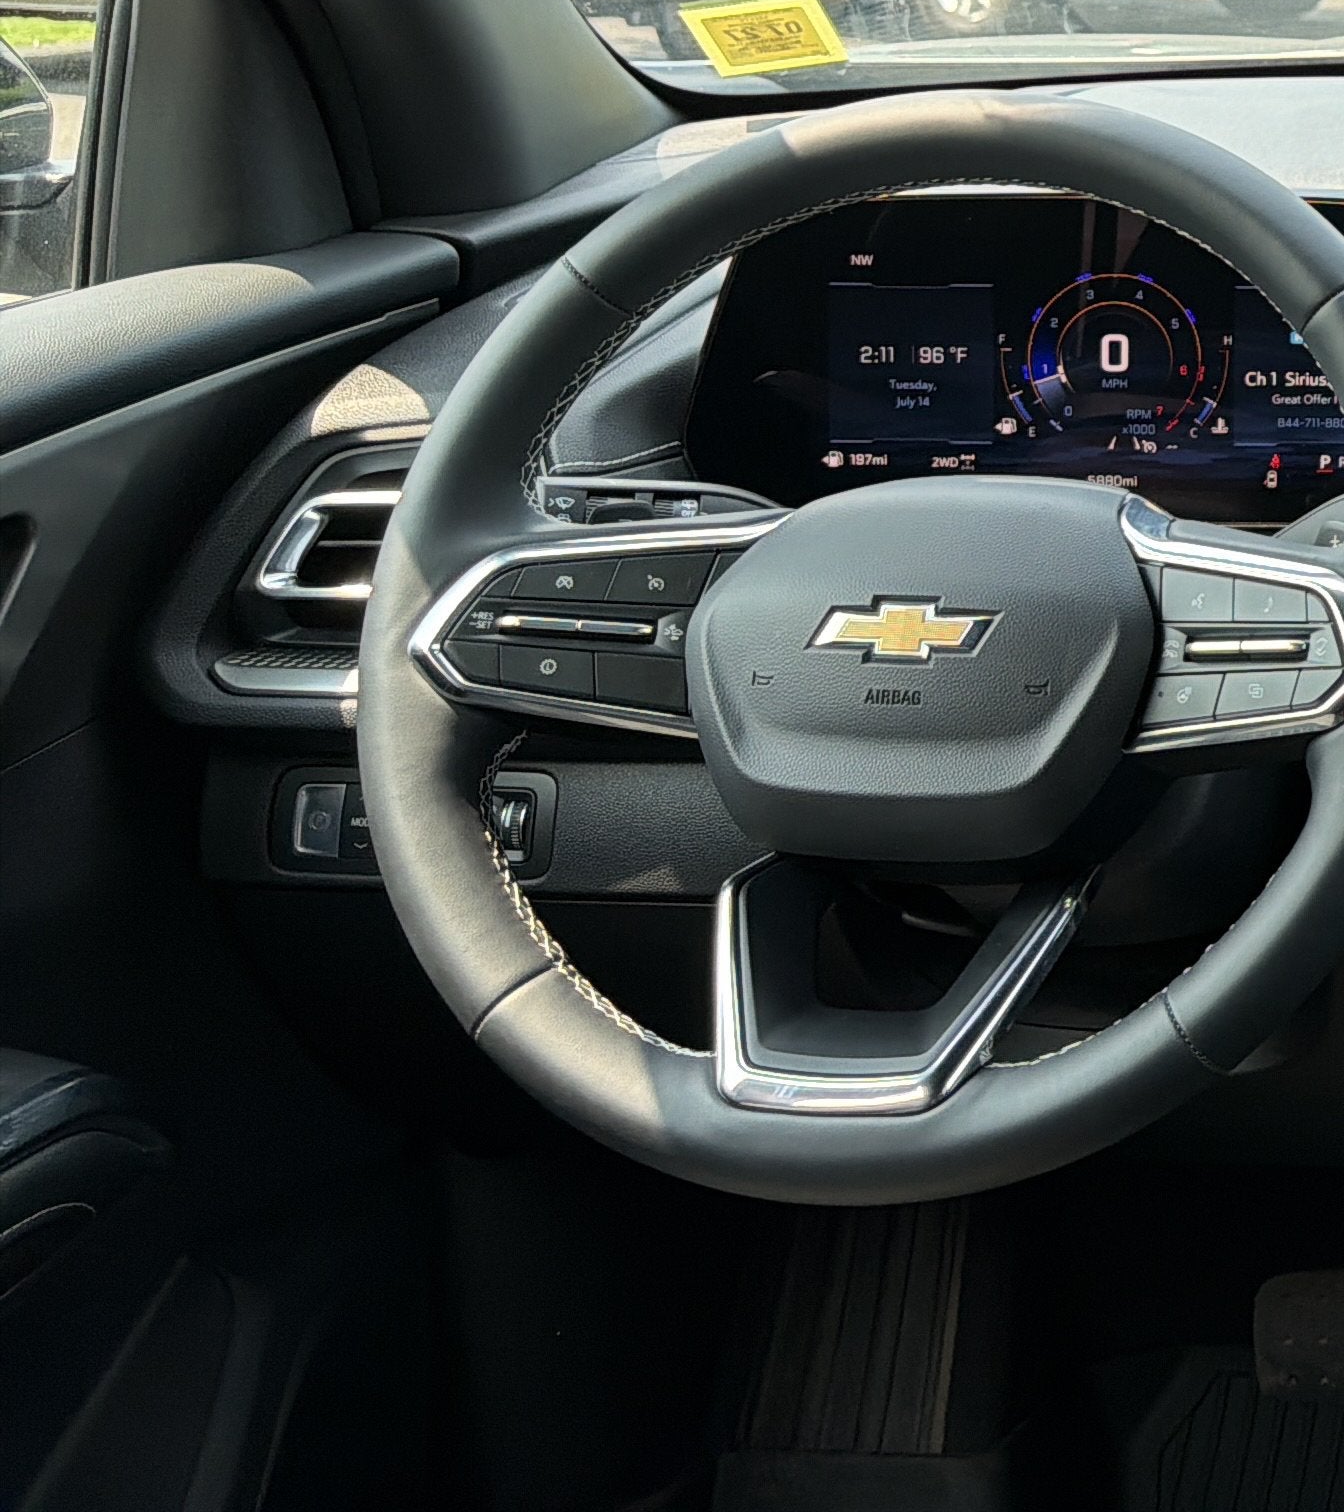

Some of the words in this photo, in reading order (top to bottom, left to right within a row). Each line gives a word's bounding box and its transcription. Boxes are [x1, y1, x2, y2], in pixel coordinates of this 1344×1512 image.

[850, 253, 874, 268] NW
[1086, 289, 1095, 301] 3
[1135, 289, 1144, 301] 4
[1050, 317, 1060, 329] 2
[1170, 317, 1180, 330] 5
[998, 333, 1006, 346] F
[1223, 334, 1233, 347] H
[858, 345, 896, 365] 2:11
[918, 345, 946, 365] 96
[1100, 333, 1130, 373] 0
[1179, 364, 1189, 377] 6
[1102, 377, 1129, 390] MPH
[1244, 370, 1269, 388] Ch
[1271, 371, 1278, 387] 1
[888, 378, 938, 394] Tuesday,
[895, 395, 913, 410] July
[914, 396, 931, 408] 14
[1271, 393, 1302, 406] Great
[1303, 393, 1333, 406] Offer
[1063, 405, 1073, 418] 0
[1126, 408, 1153, 421] RPM
[1155, 405, 1165, 418] 7
[1028, 425, 1037, 439] E
[1121, 422, 1157, 436] x1000
[1189, 426, 1199, 439] C
[849, 452, 889, 468] 197mi
[931, 455, 959, 470] 2WD
[1318, 454, 1332, 470] P
[863, 688, 923, 707] AIRBAG
